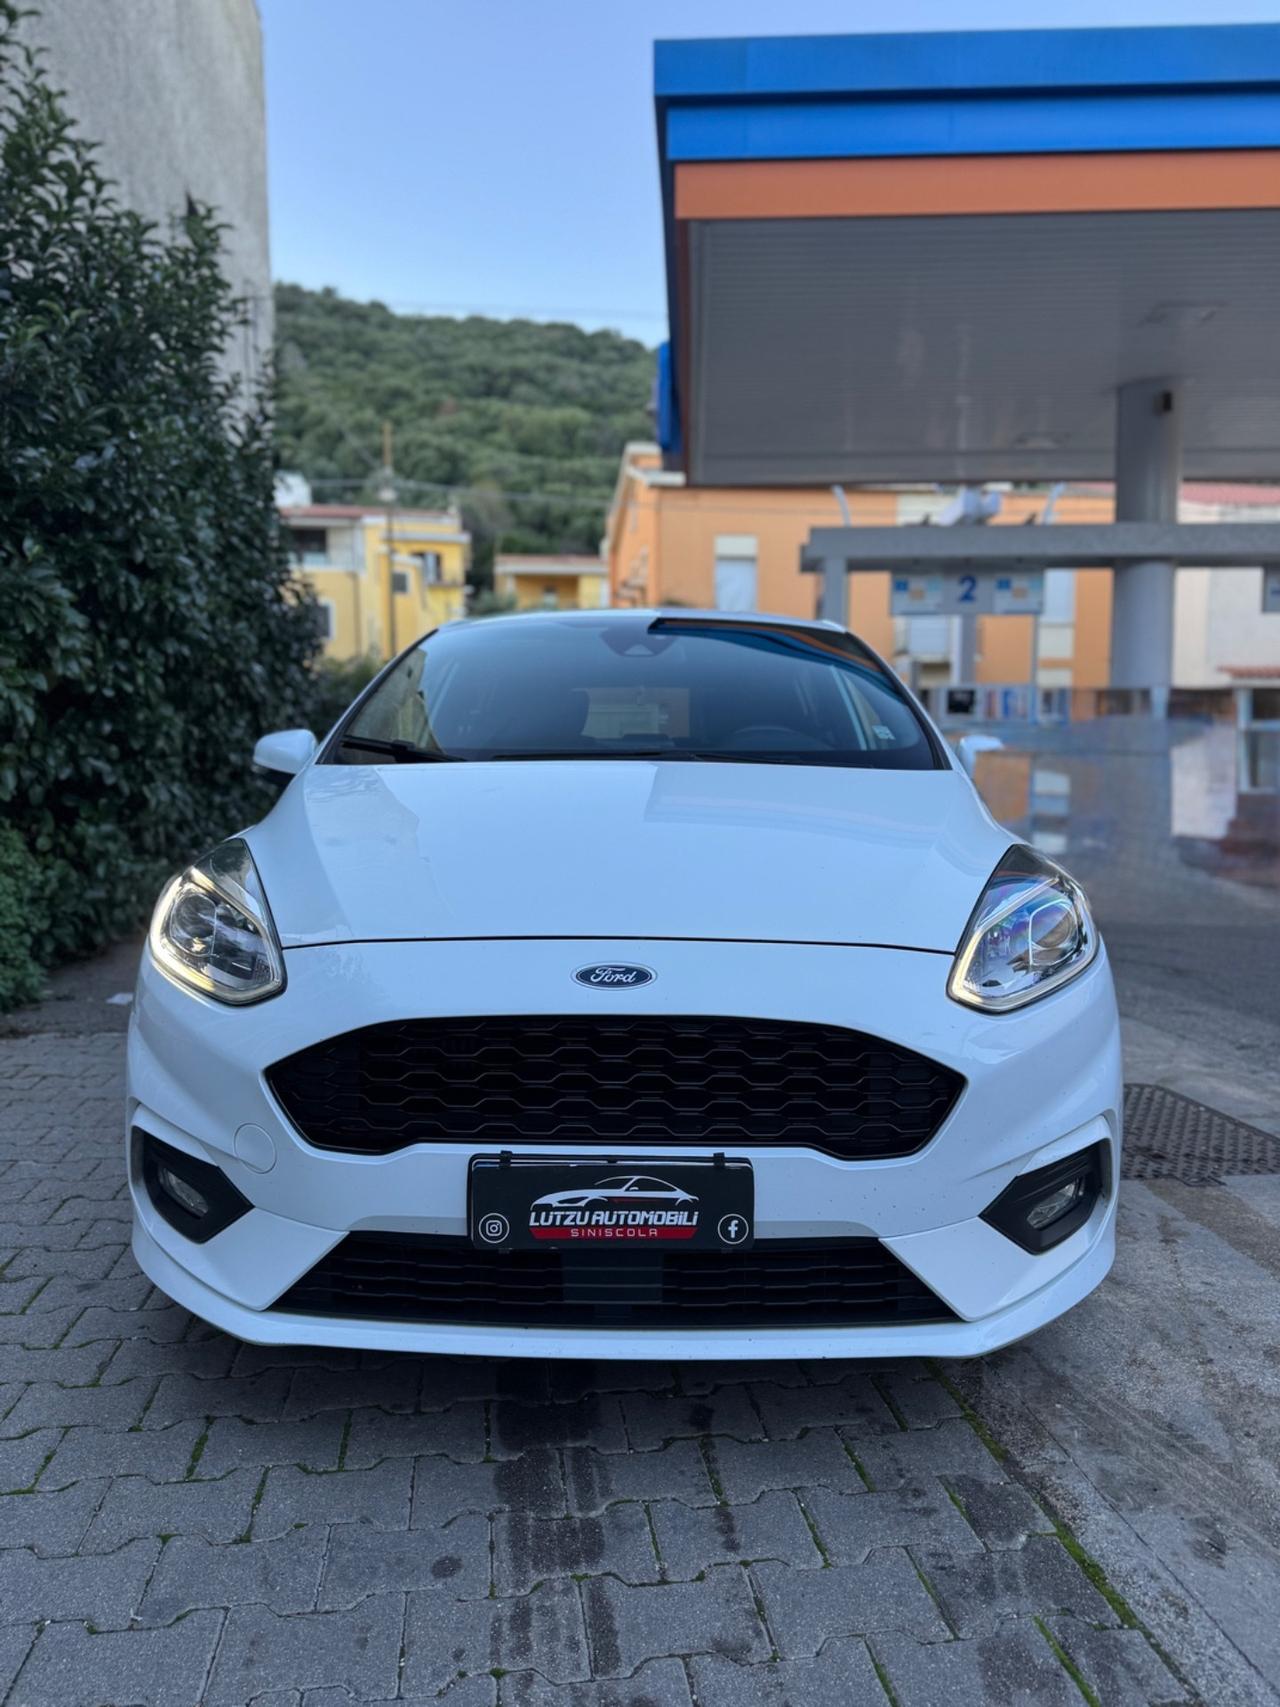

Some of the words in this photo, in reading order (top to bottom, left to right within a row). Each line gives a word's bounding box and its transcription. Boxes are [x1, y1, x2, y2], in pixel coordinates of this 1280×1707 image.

[958, 575, 977, 602] 2
[590, 966, 638, 983] Ford
[529, 1211, 591, 1226] LUTZU
[570, 1228, 658, 1237] SINISCOLA
